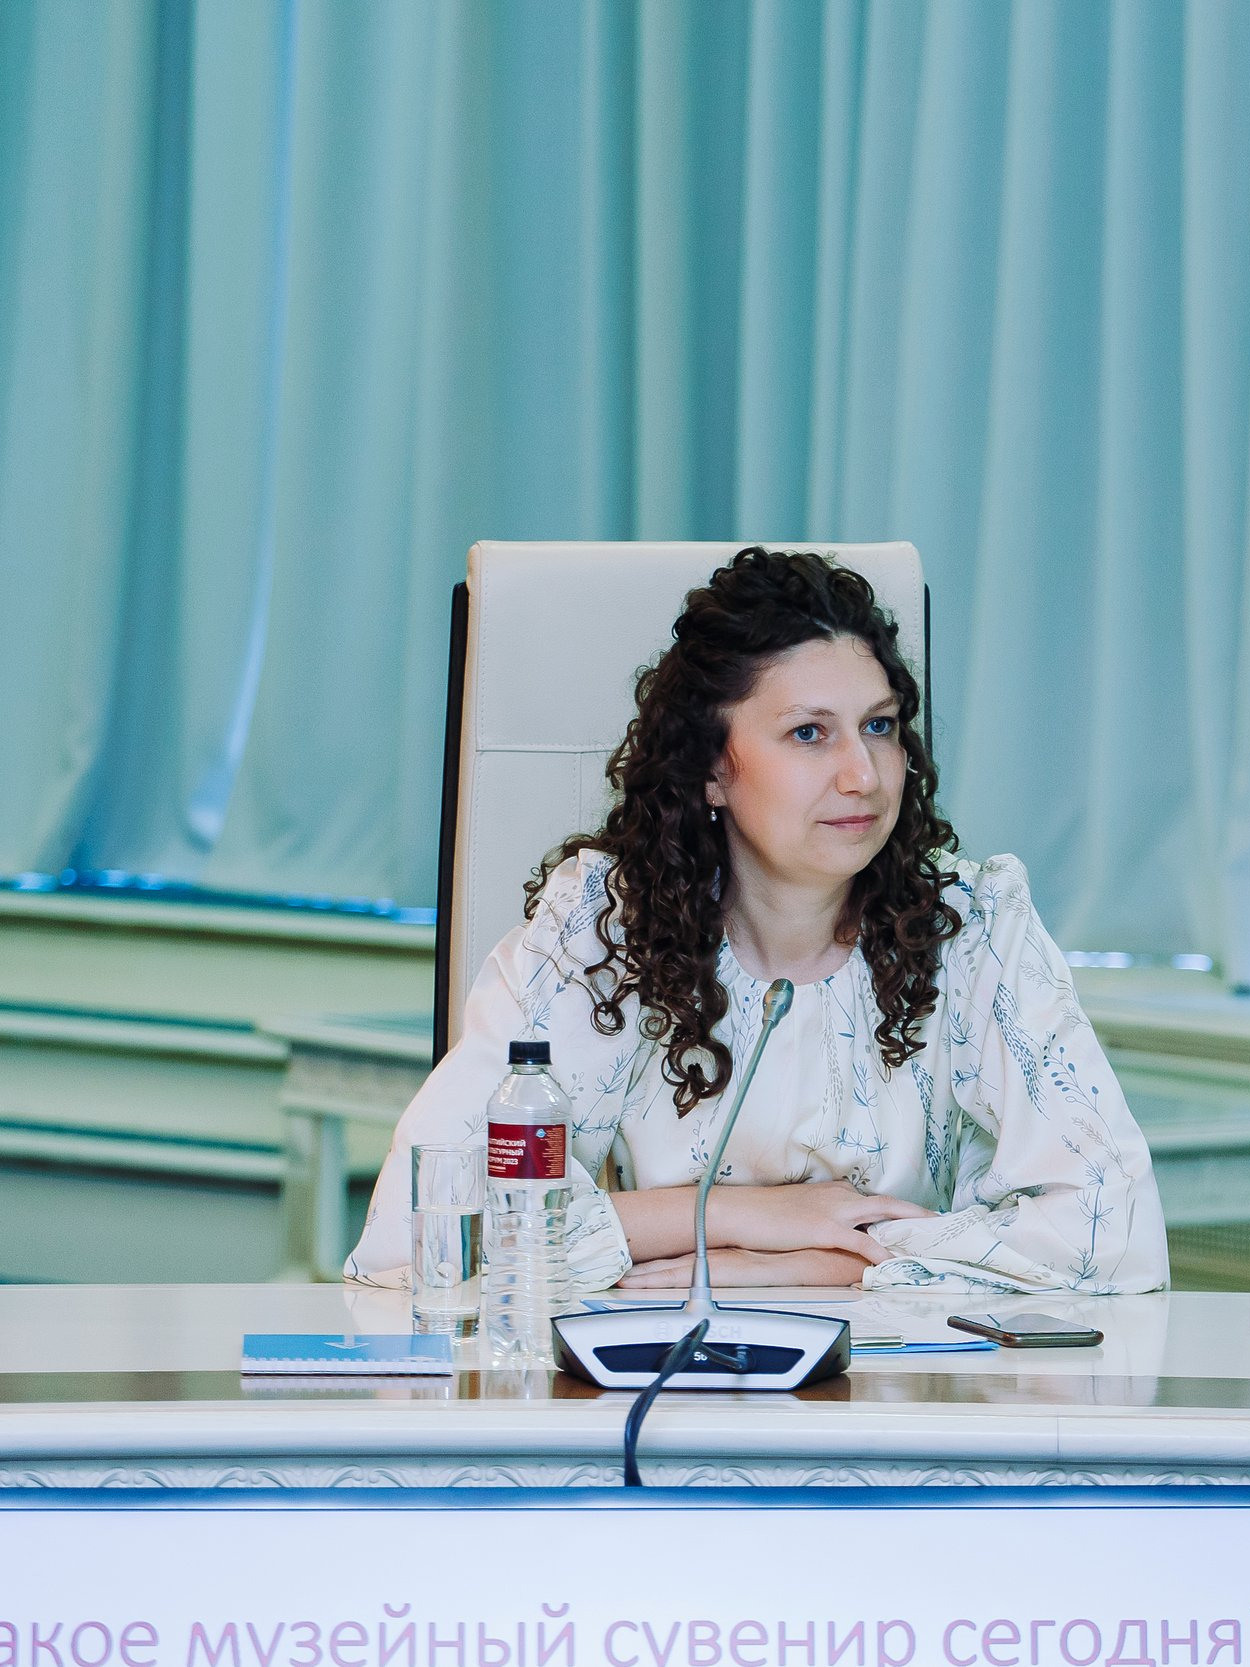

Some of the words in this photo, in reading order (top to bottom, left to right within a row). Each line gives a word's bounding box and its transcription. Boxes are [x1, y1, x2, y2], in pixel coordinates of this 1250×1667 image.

[683, 1324, 742, 1338] BSCH
[187, 1602, 576, 1667] музейный
[603, 1619, 917, 1667] сувенир
